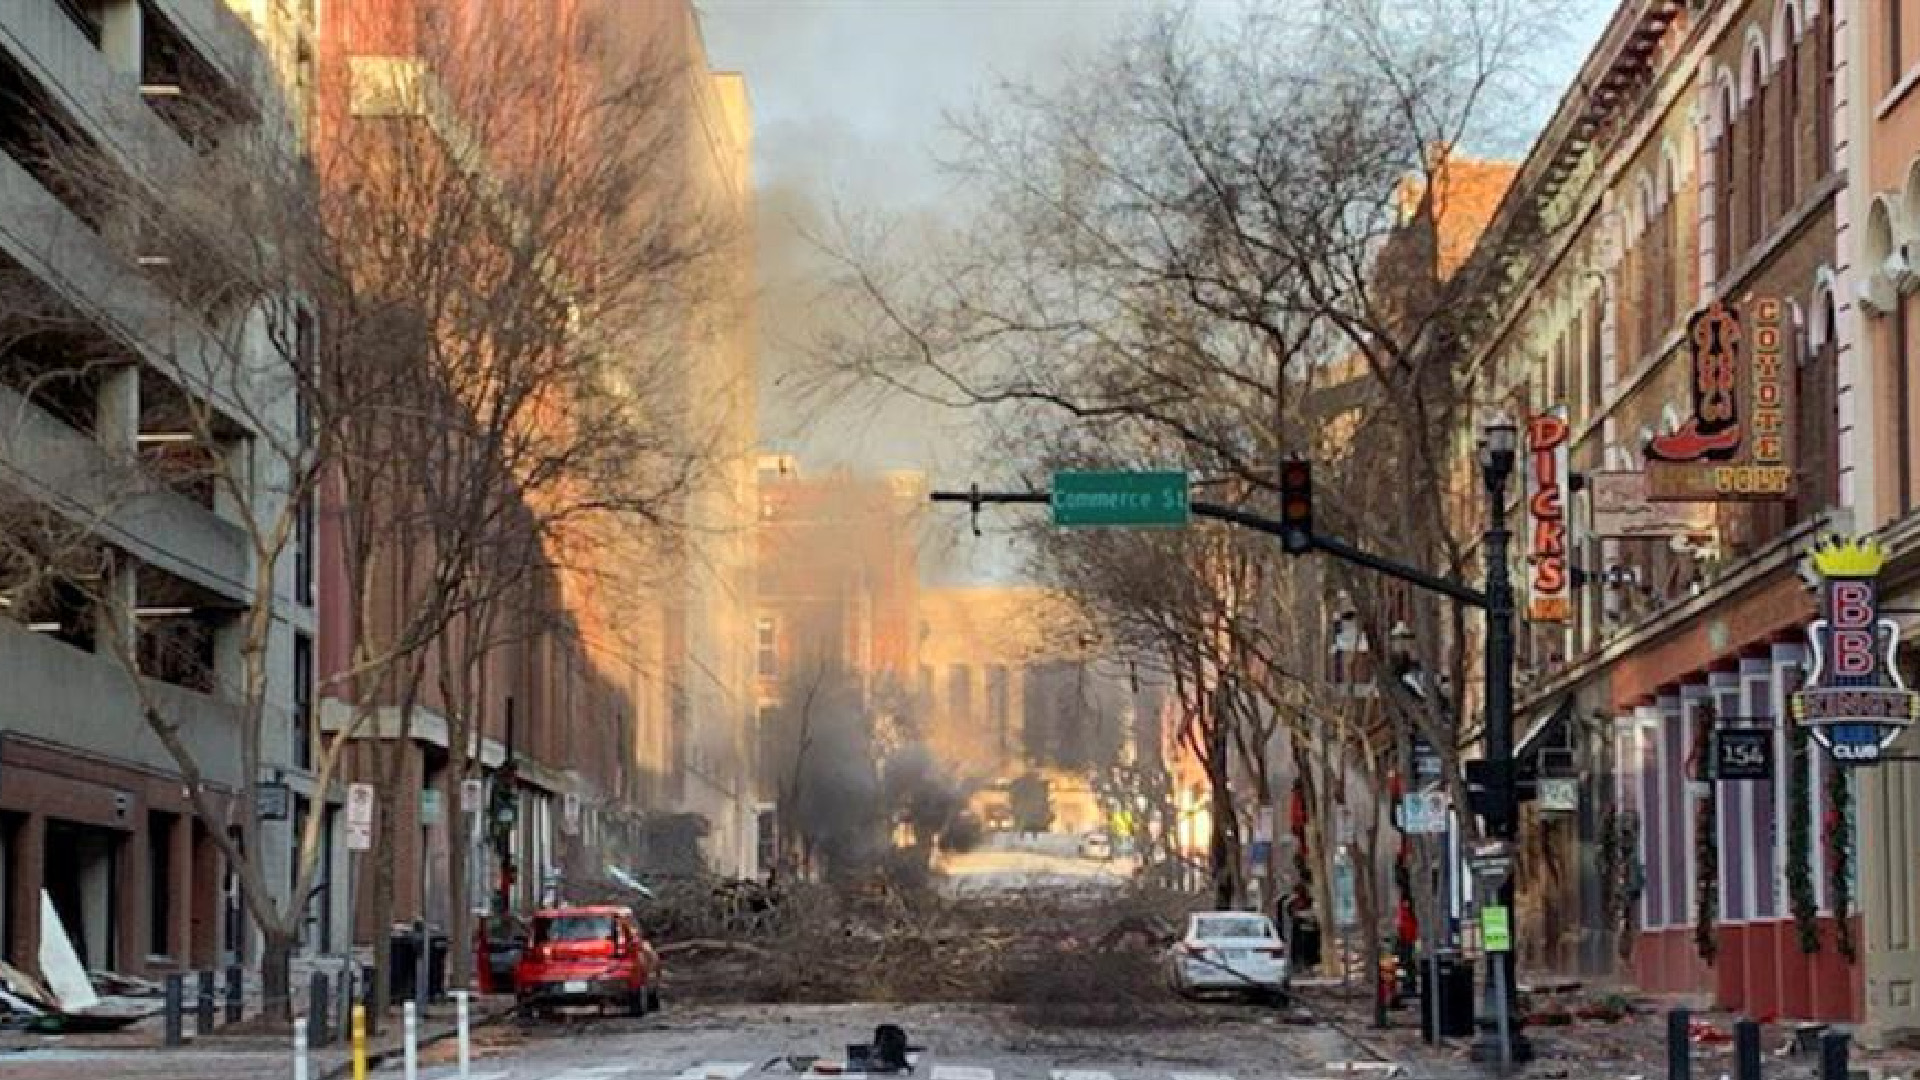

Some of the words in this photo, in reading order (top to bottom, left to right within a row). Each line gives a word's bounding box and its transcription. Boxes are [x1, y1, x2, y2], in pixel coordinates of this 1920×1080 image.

[1053, 489, 1151, 510] Commerce
[1162, 487, 1184, 510] St
[1832, 744, 1879, 760] CLUB
